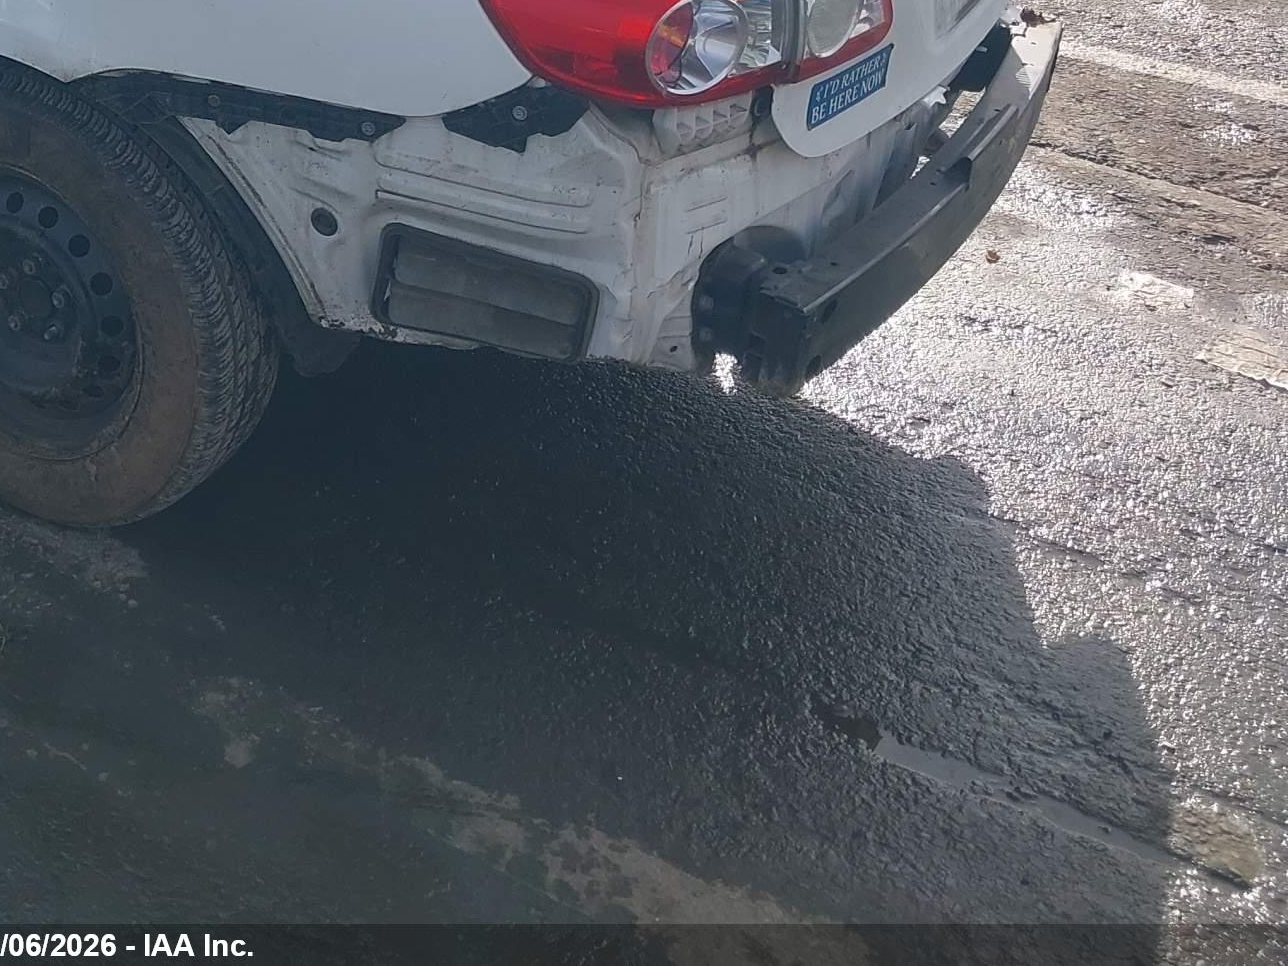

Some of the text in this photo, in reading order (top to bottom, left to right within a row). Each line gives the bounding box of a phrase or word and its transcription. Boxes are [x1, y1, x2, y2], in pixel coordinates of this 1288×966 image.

[811, 68, 886, 124] BE HERE NOW
[824, 55, 881, 99] I'D RATHER
